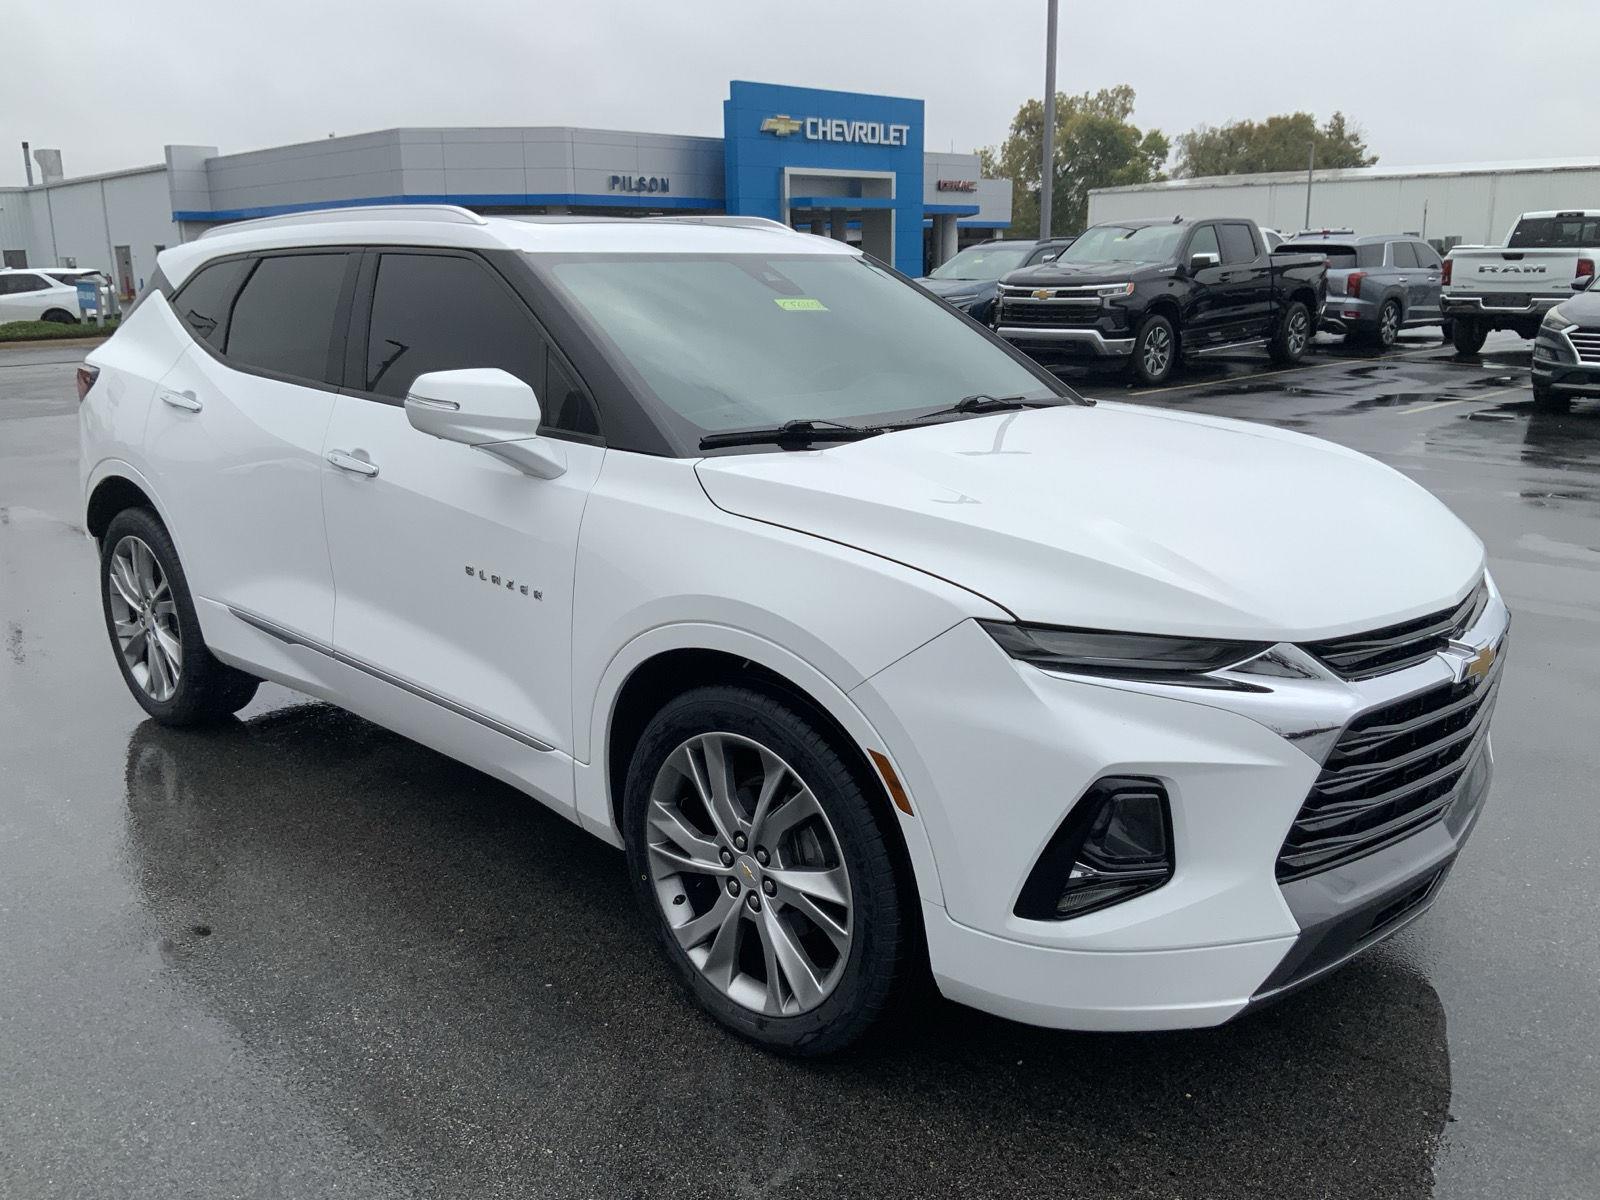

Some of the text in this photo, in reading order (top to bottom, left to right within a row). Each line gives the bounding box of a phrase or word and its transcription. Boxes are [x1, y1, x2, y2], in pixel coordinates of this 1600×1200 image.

[805, 117, 910, 146] CHEVROLET
[609, 175, 670, 193] PILSON
[1478, 263, 1547, 273] RAM
[465, 565, 543, 602] BLAZER
